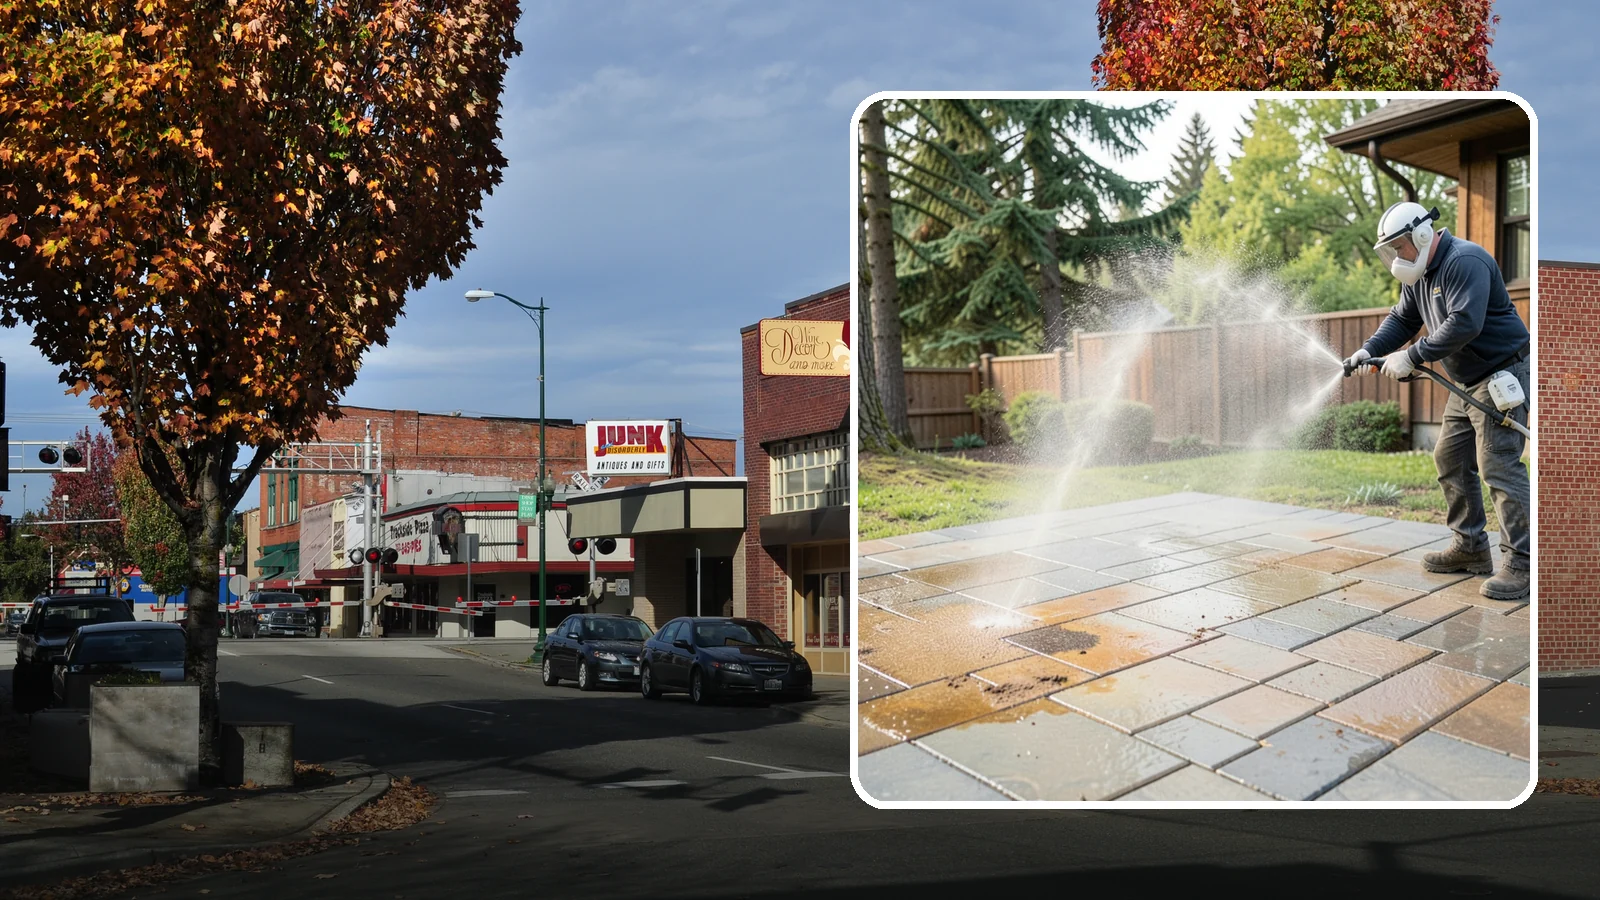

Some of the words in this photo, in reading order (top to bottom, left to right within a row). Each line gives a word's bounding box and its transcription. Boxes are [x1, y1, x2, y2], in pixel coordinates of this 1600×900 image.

[596, 425, 665, 457] JUNK
[597, 461, 628, 470] ANTIQUES
[631, 461, 644, 470] AND
[647, 460, 665, 469] GIFTS
[390, 521, 413, 539] Trackside
[414, 519, 429, 534] Pizza
